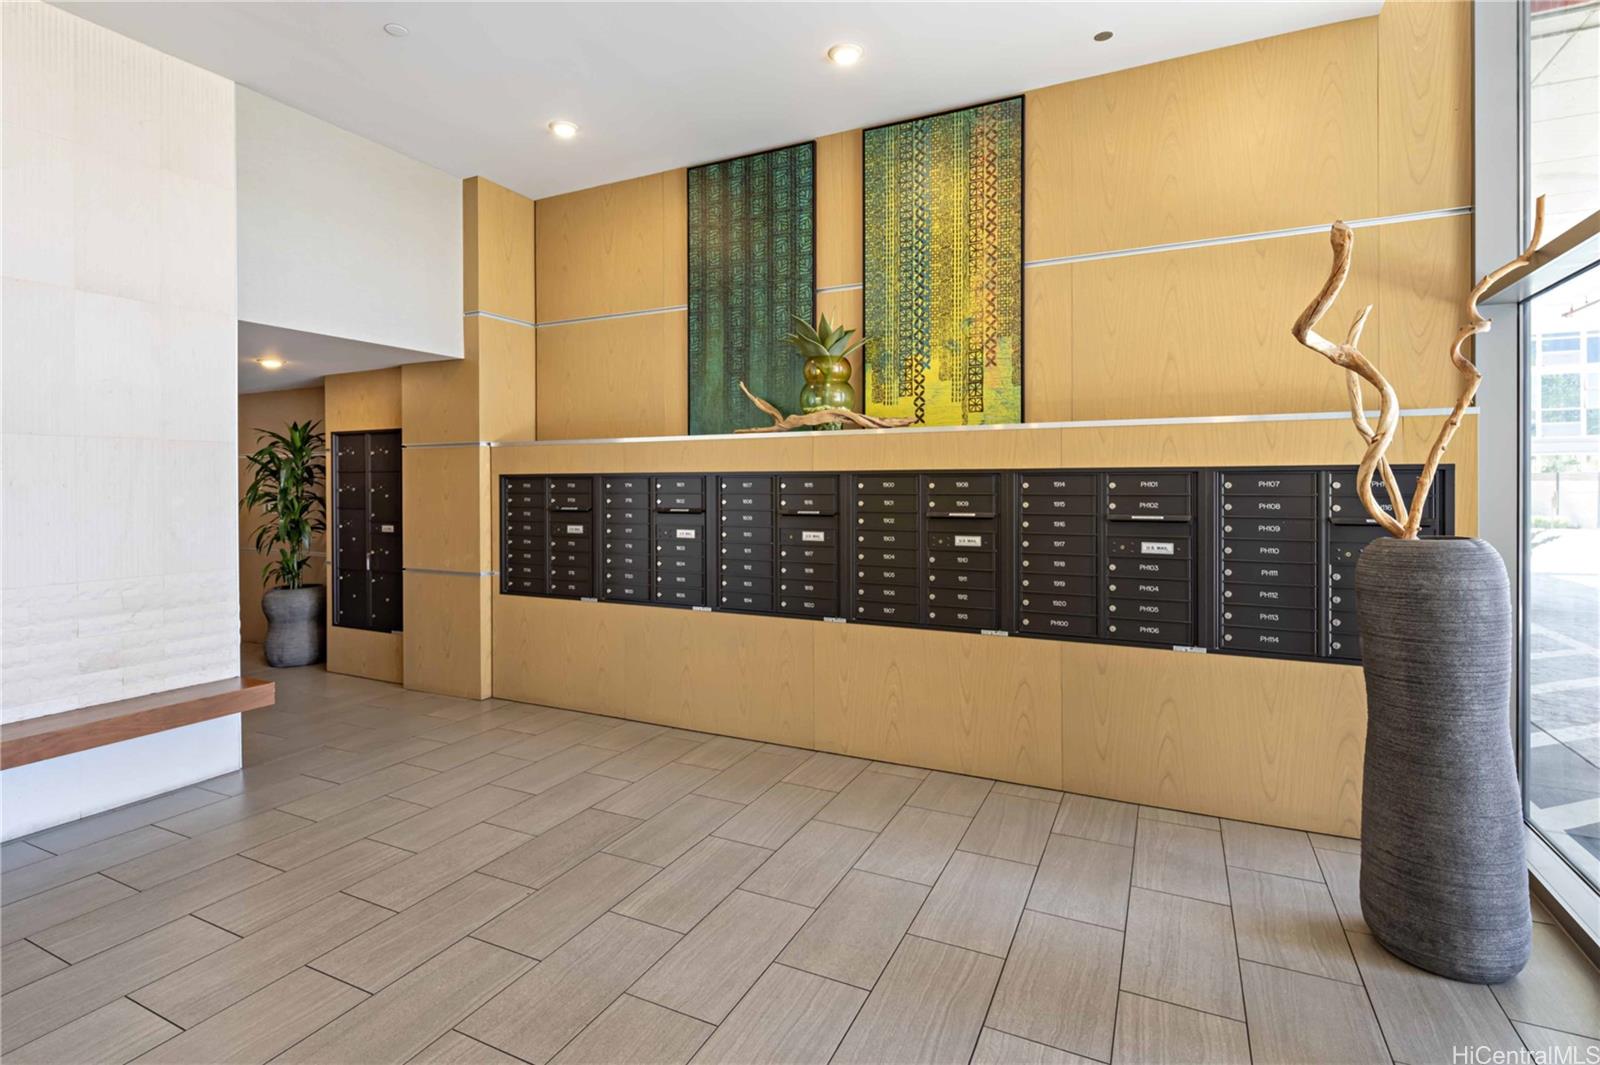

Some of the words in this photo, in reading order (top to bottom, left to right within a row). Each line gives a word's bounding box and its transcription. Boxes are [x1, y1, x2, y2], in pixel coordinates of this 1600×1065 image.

[1257, 480, 1281, 488] PH107
[1258, 502, 1281, 510] PH108
[1257, 524, 1281, 533] PH109
[1053, 540, 1066, 548] 1917
[1259, 547, 1280, 555] PH110
[1139, 563, 1160, 572] PH103
[1260, 569, 1279, 577] PH111
[1139, 584, 1160, 593] PH104
[1259, 591, 1279, 599] PH112
[1139, 605, 1160, 613] PH105
[1259, 613, 1280, 621] PH113
[1050, 619, 1069, 627] PH100
[1139, 626, 1160, 634] PH106
[1259, 635, 1280, 644] PH114
